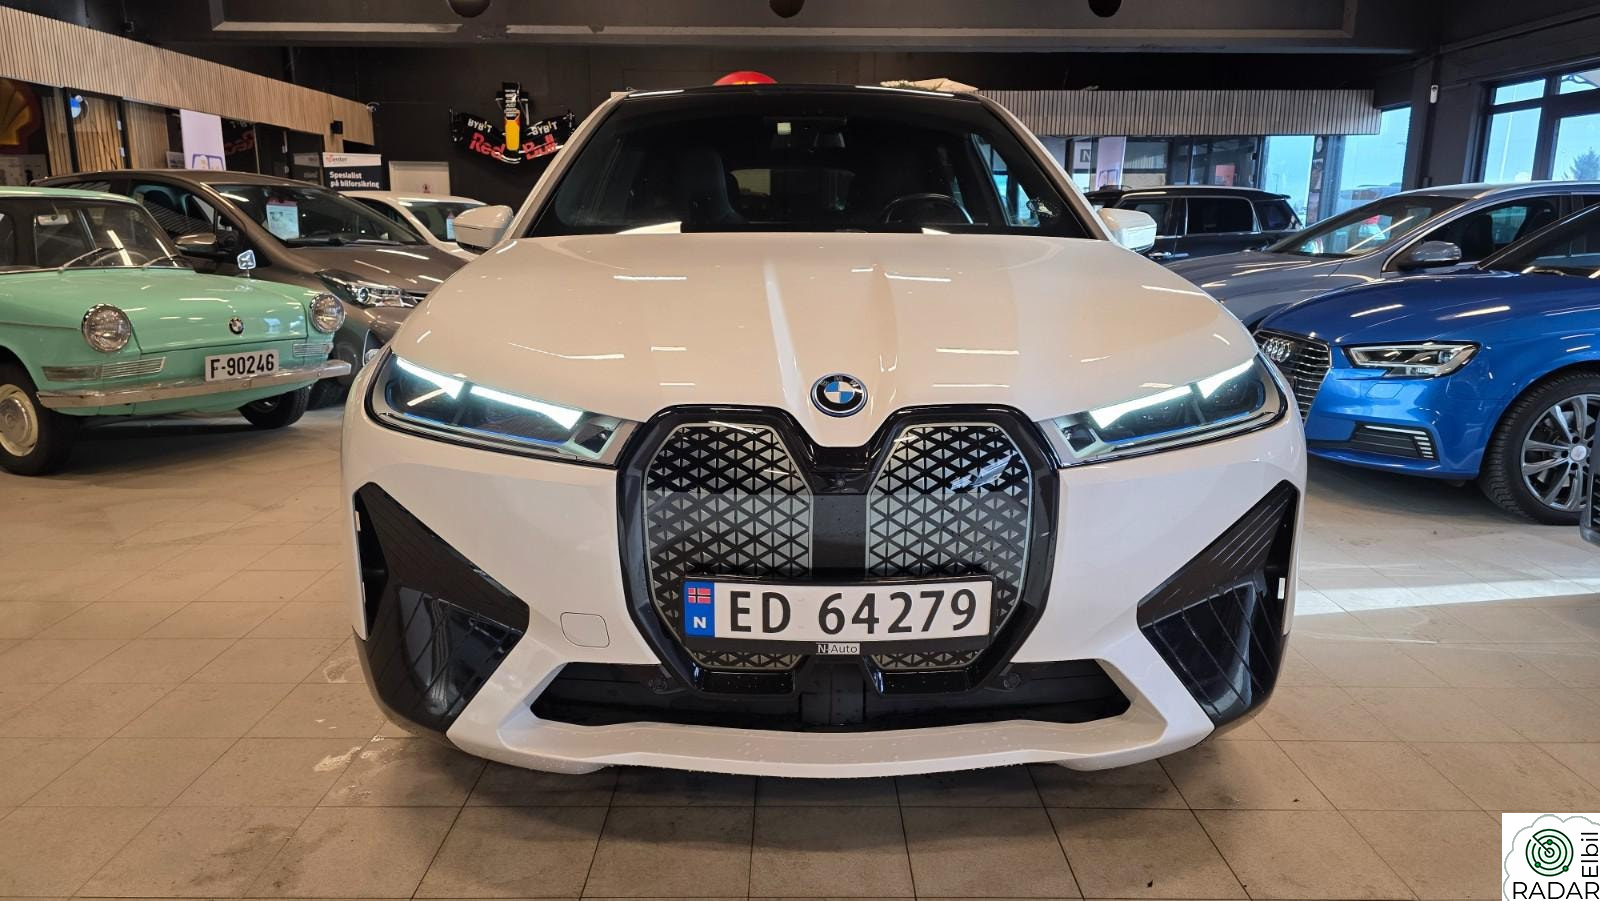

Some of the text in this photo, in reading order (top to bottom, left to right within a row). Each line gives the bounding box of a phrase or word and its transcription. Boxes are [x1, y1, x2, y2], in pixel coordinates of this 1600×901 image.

[469, 132, 506, 160] Red
[329, 171, 362, 179] Spesialist
[330, 180, 380, 189] på bilforsikring
[210, 353, 275, 379] F-90246
[729, 588, 977, 635] ED 64279
[693, 616, 707, 629] N
